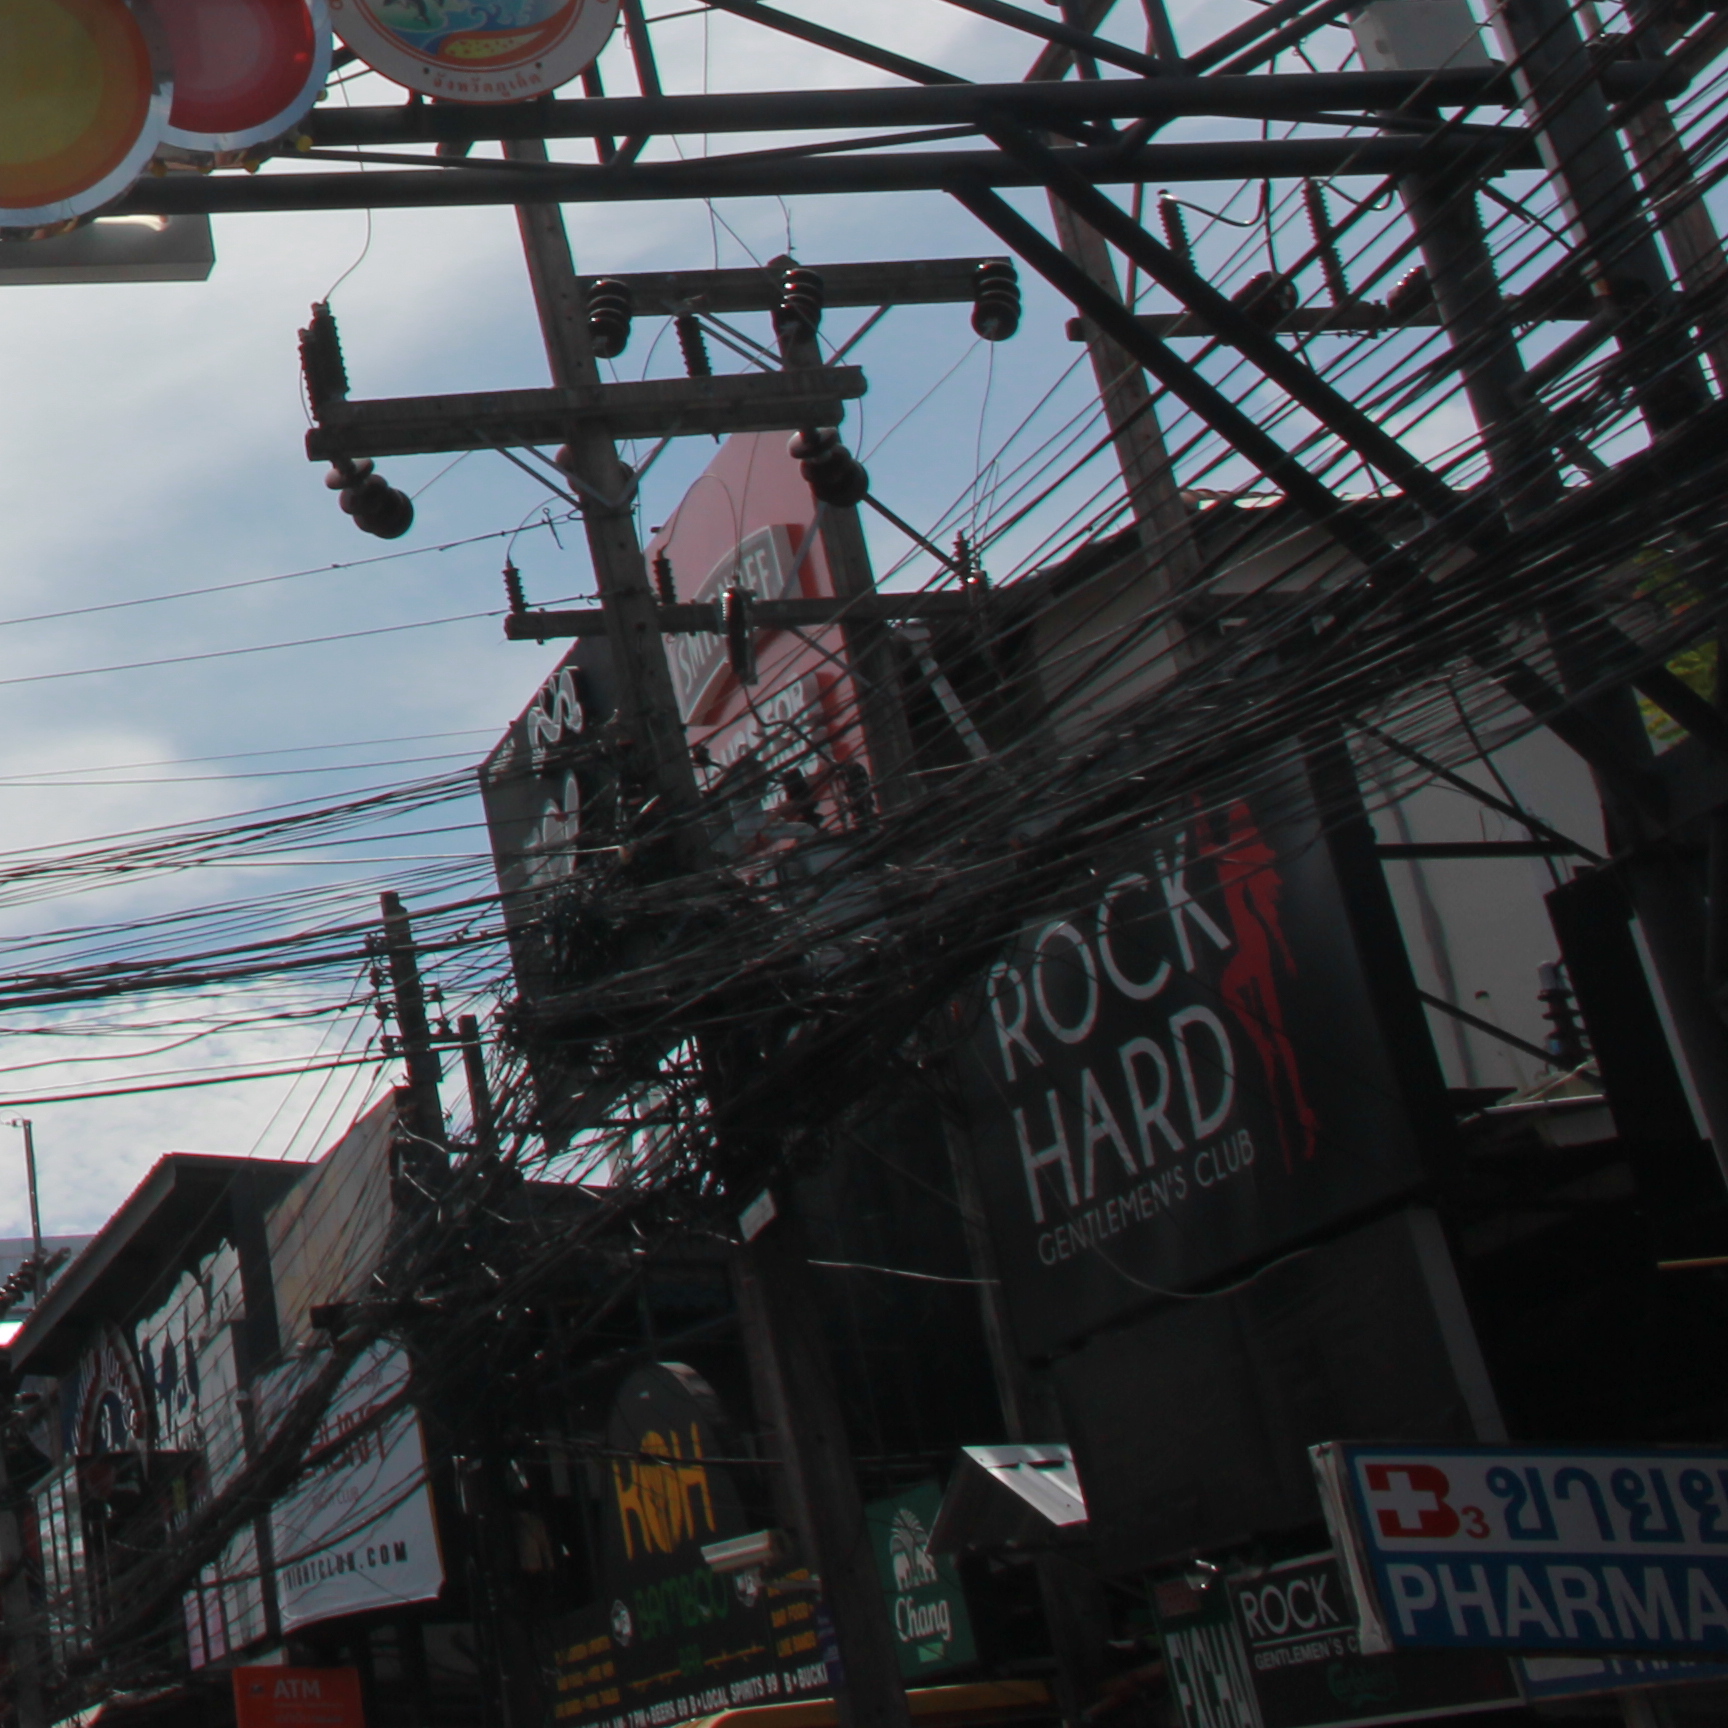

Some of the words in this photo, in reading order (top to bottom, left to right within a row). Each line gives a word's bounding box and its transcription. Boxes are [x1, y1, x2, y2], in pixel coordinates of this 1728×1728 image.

[987, 831, 1232, 1083] ROCK
[1013, 1005, 1236, 1224] HARD
[1037, 1164, 1188, 1266] GENTLEMEN'S
[1194, 1128, 1256, 1188] CLUB
[894, 1595, 953, 1642] Chang
[1239, 1573, 1339, 1639] ROCK
[1254, 1636, 1344, 1671] GENTLEMEN'S
[272, 1677, 322, 1700] ATM
